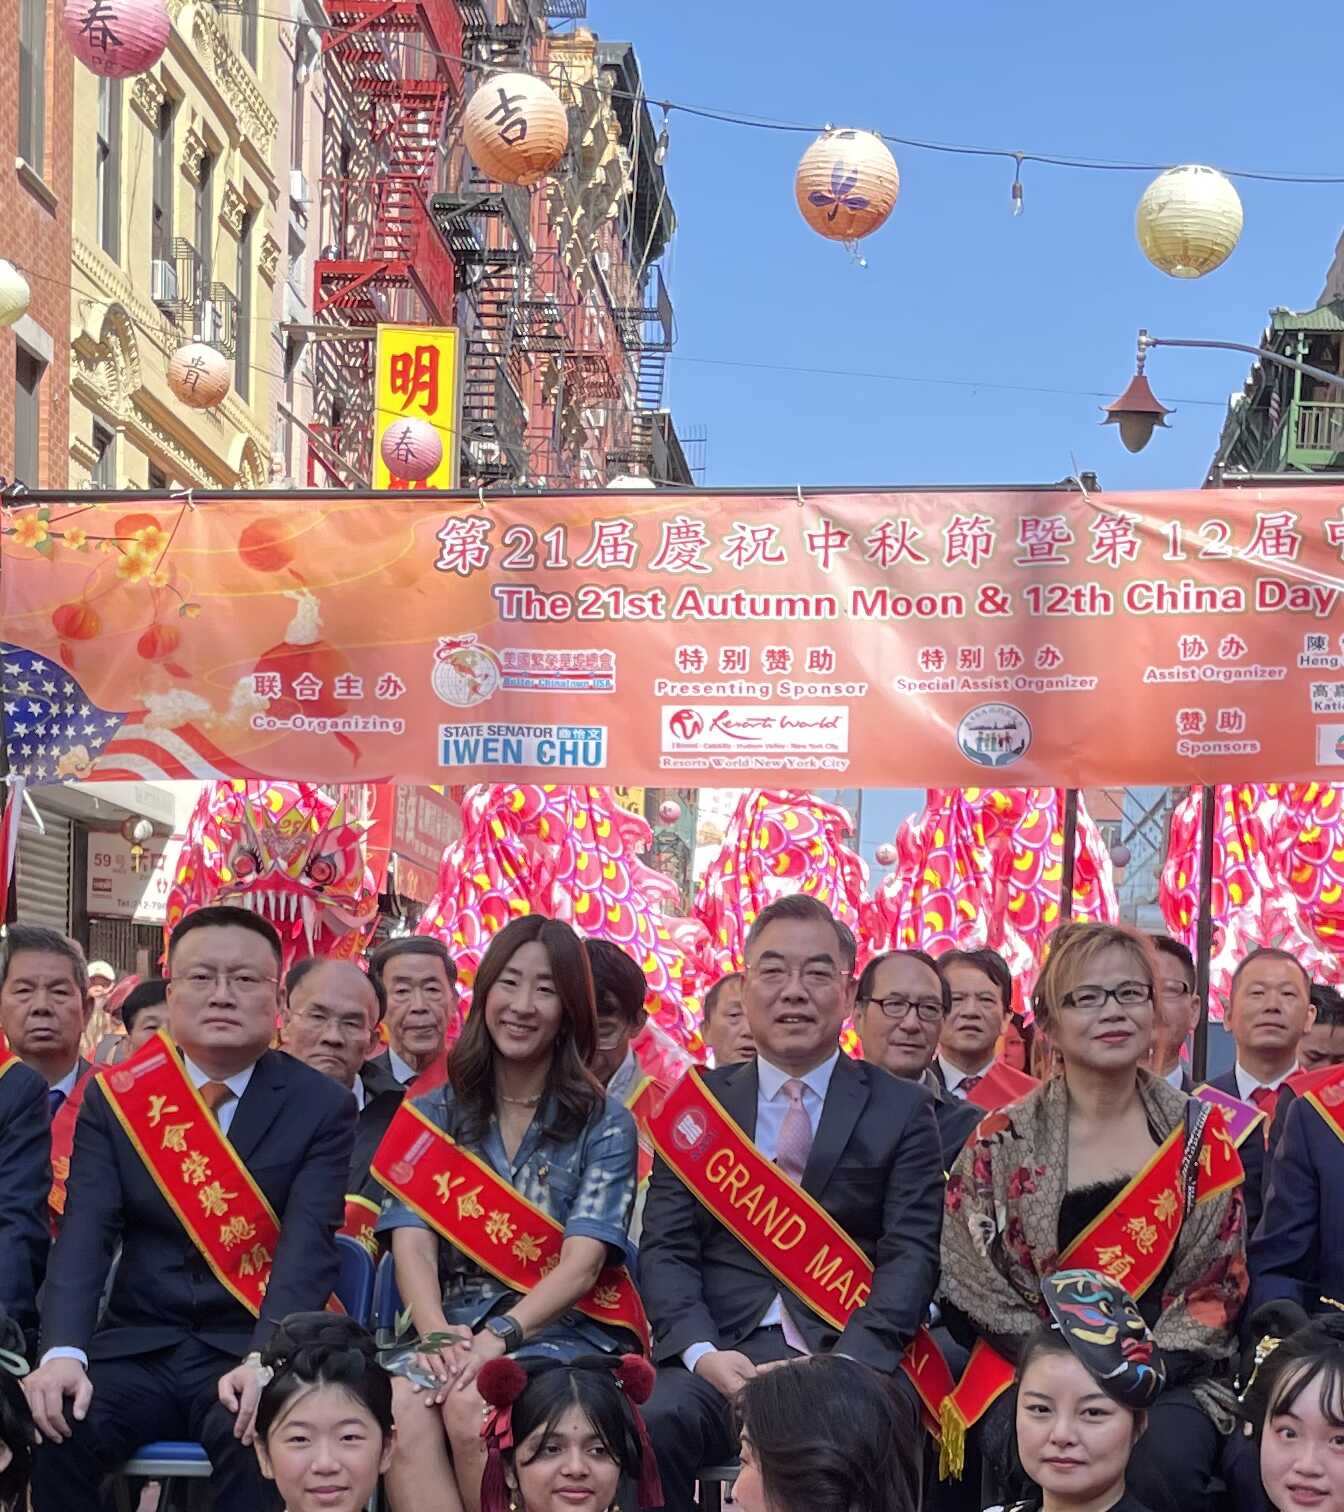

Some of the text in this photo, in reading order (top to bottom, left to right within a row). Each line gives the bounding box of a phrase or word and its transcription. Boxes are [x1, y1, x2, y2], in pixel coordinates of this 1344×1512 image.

[79, 0, 125, 52] 春
[484, 87, 528, 144] 吉
[391, 426, 419, 465] 春
[496, 585, 571, 620] The
[578, 584, 665, 620] 21st
[676, 586, 837, 621] Autumn
[850, 584, 975, 618] Moon
[977, 583, 1020, 617] &
[1026, 582, 1112, 616] 12th
[1123, 580, 1245, 614] China
[1257, 579, 1337, 617] Day
[920, 645, 1062, 671] 特别协办
[1180, 636, 1246, 659] 协办
[678, 648, 834, 672] 特别赞助
[1300, 654, 1338, 667] Heng
[897, 675, 1096, 693] Special Assist Organizer
[1146, 665, 1285, 682] Assist Organizer
[253, 672, 406, 700] 联合主办
[657, 681, 867, 697] Presenting Sponsor
[251, 714, 405, 735] Co-Organizing
[443, 725, 553, 739] STATE SENATOR
[1176, 708, 1245, 734] 赞助
[442, 738, 603, 767] IWEN CHU
[1179, 739, 1258, 755] Sponsors
[662, 757, 848, 771] Resorts World New York City
[94, 853, 111, 867] 59
[705, 1148, 808, 1251] GRAND
